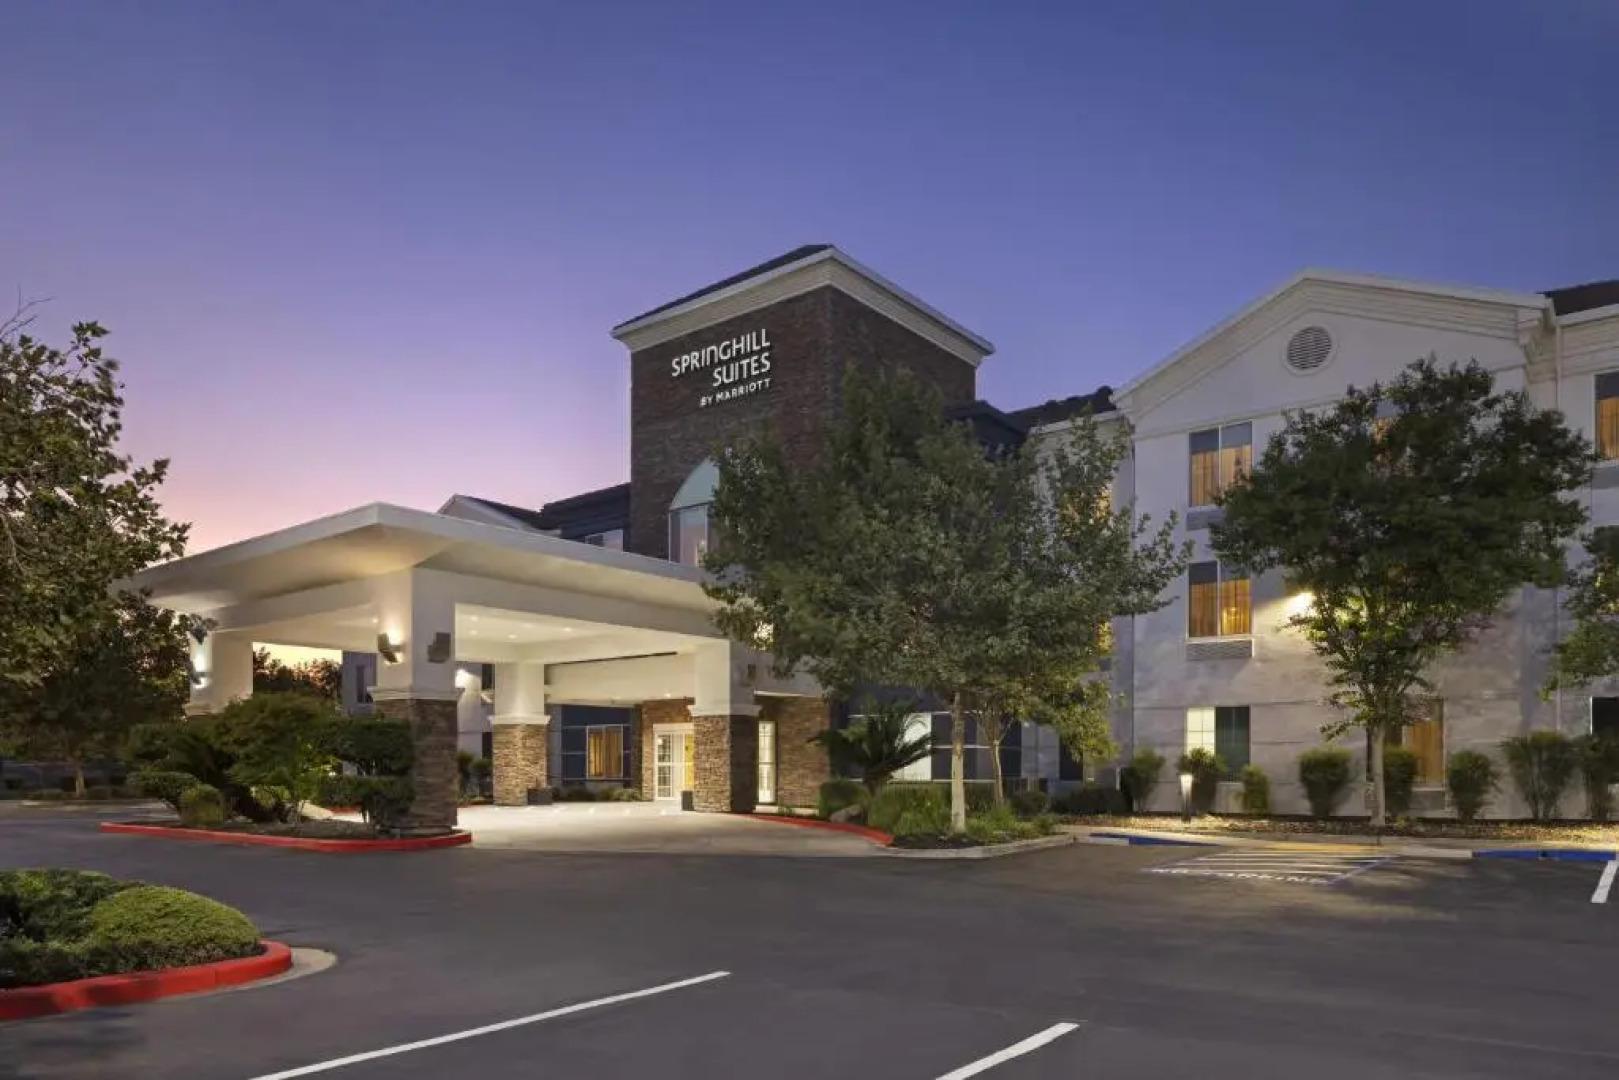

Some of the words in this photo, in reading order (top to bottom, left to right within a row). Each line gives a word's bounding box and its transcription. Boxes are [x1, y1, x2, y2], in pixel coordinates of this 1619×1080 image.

[671, 328, 771, 377] SPRINGHILL
[712, 352, 771, 387] SUITES
[699, 396, 713, 407] BY
[715, 378, 771, 402] MARRIOTT
